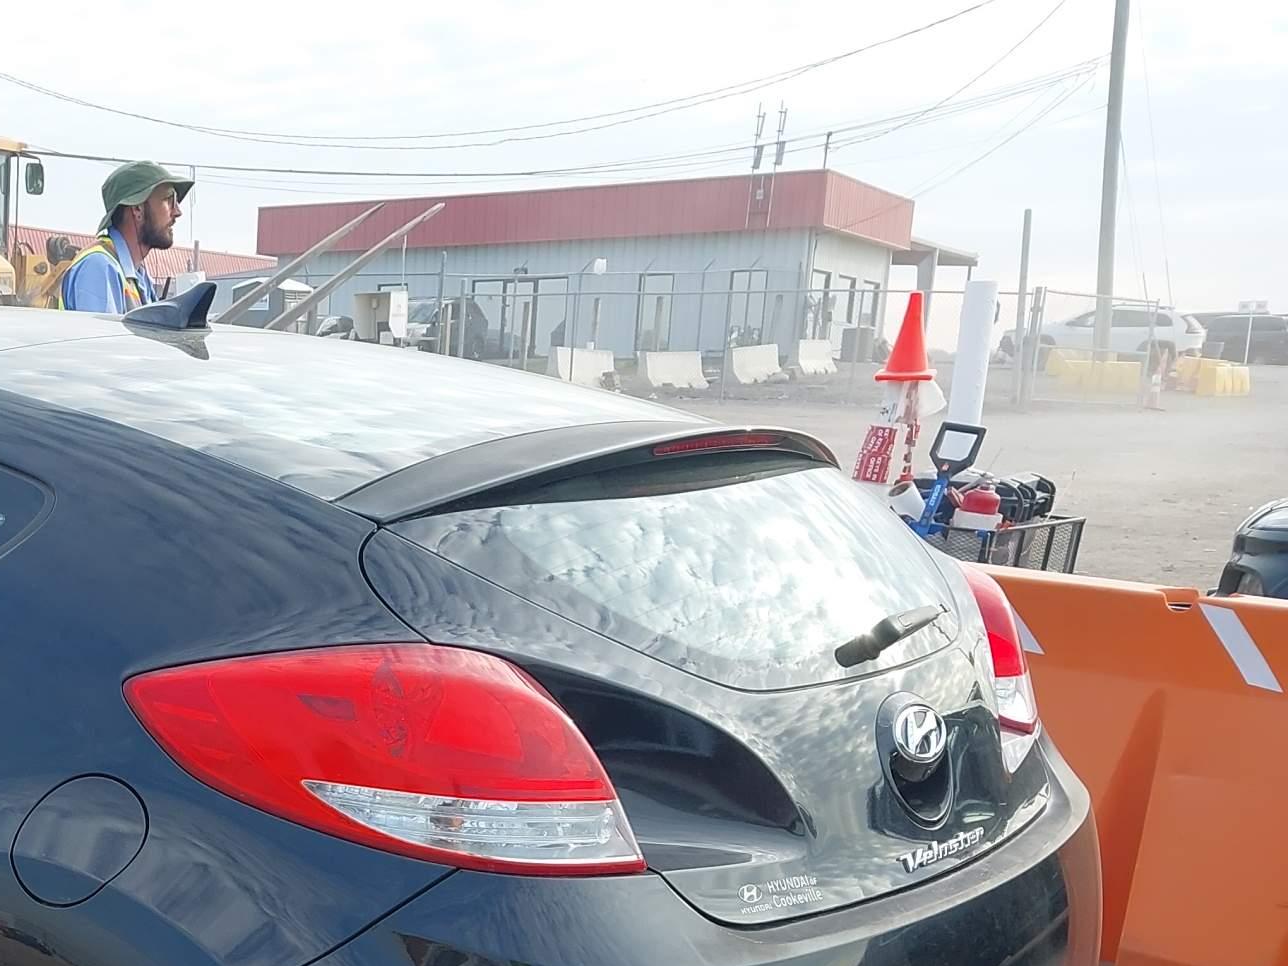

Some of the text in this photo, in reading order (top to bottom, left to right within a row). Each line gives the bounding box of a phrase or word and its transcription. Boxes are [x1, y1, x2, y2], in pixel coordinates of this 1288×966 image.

[898, 826, 985, 873] Veloster
[766, 874, 809, 894] HYUNDAI
[772, 888, 824, 908] Cookeville
[740, 903, 773, 914] HYUNDAI
